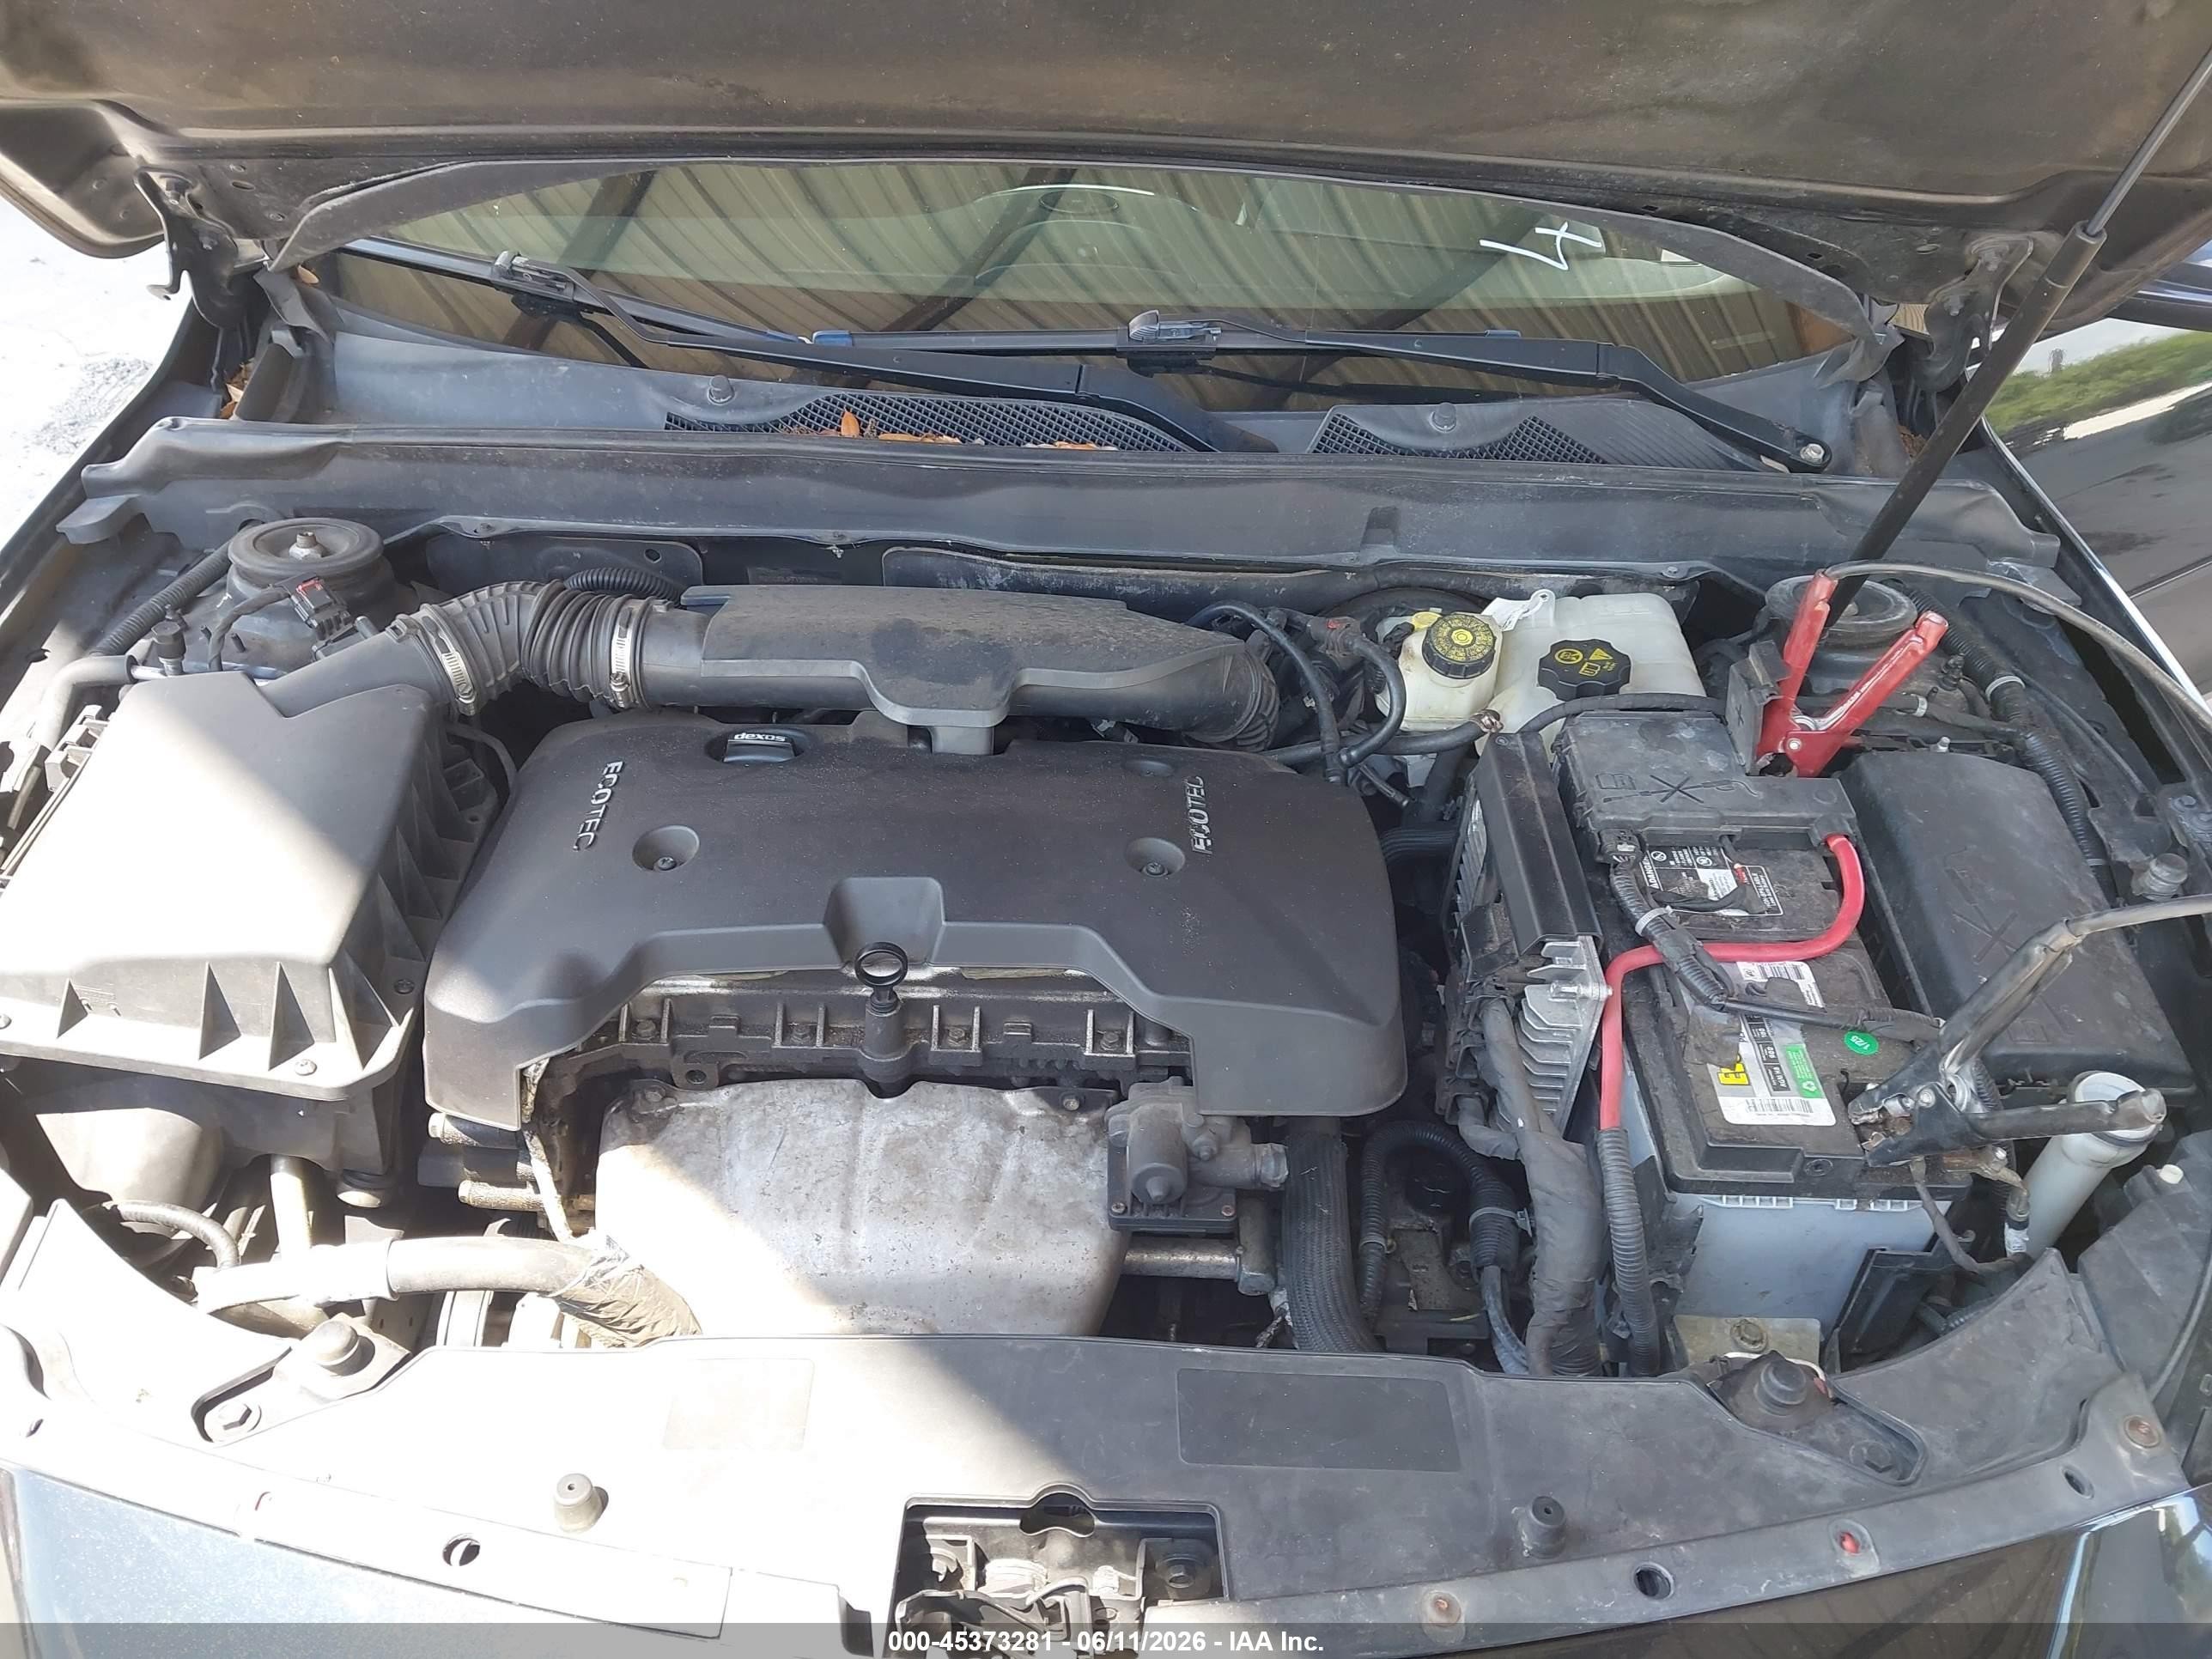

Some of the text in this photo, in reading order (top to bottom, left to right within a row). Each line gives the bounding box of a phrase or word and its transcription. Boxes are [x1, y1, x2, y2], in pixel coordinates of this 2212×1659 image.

[734, 732, 786, 742] dexos
[573, 761, 623, 851] ECOTEC
[1183, 776, 1212, 854] ECOTEC
[1850, 1036, 1870, 1049] 1/25
